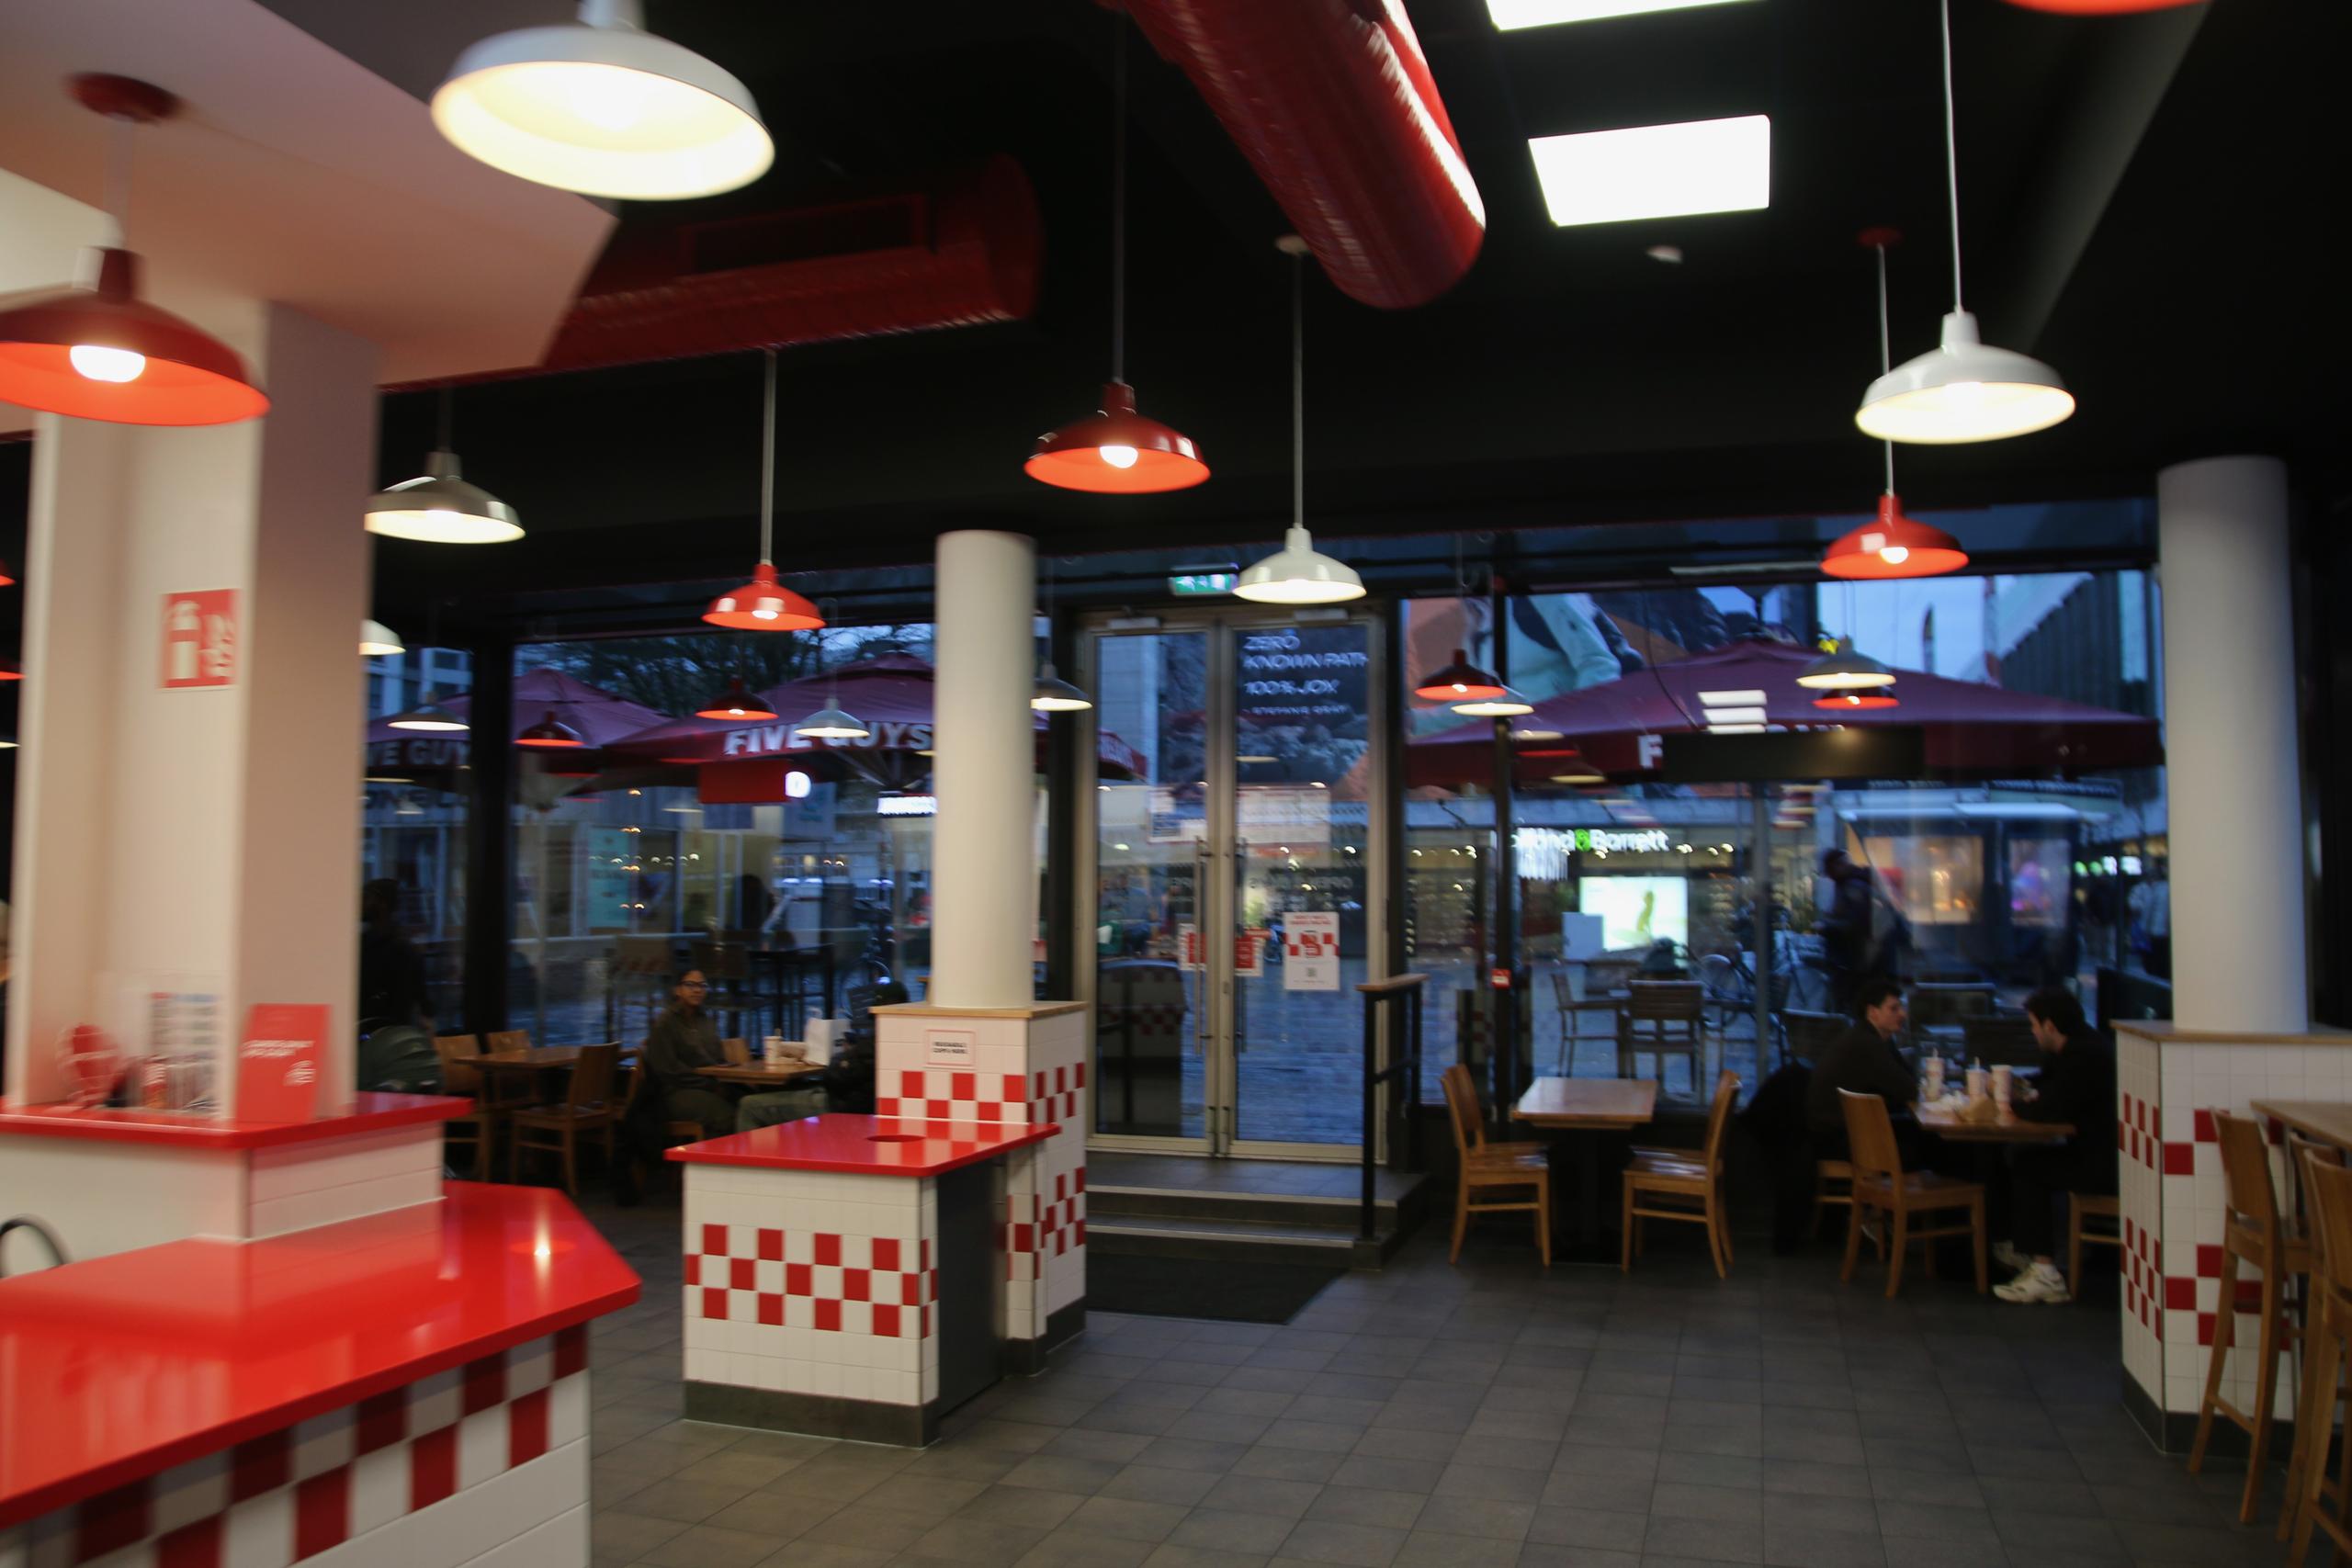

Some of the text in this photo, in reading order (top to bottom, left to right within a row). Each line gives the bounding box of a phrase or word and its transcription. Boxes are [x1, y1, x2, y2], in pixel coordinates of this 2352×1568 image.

[1244, 636, 1301, 650] ZERO
[1243, 654, 1320, 670] KNOWN
[1589, 829, 1668, 852] Barrett
